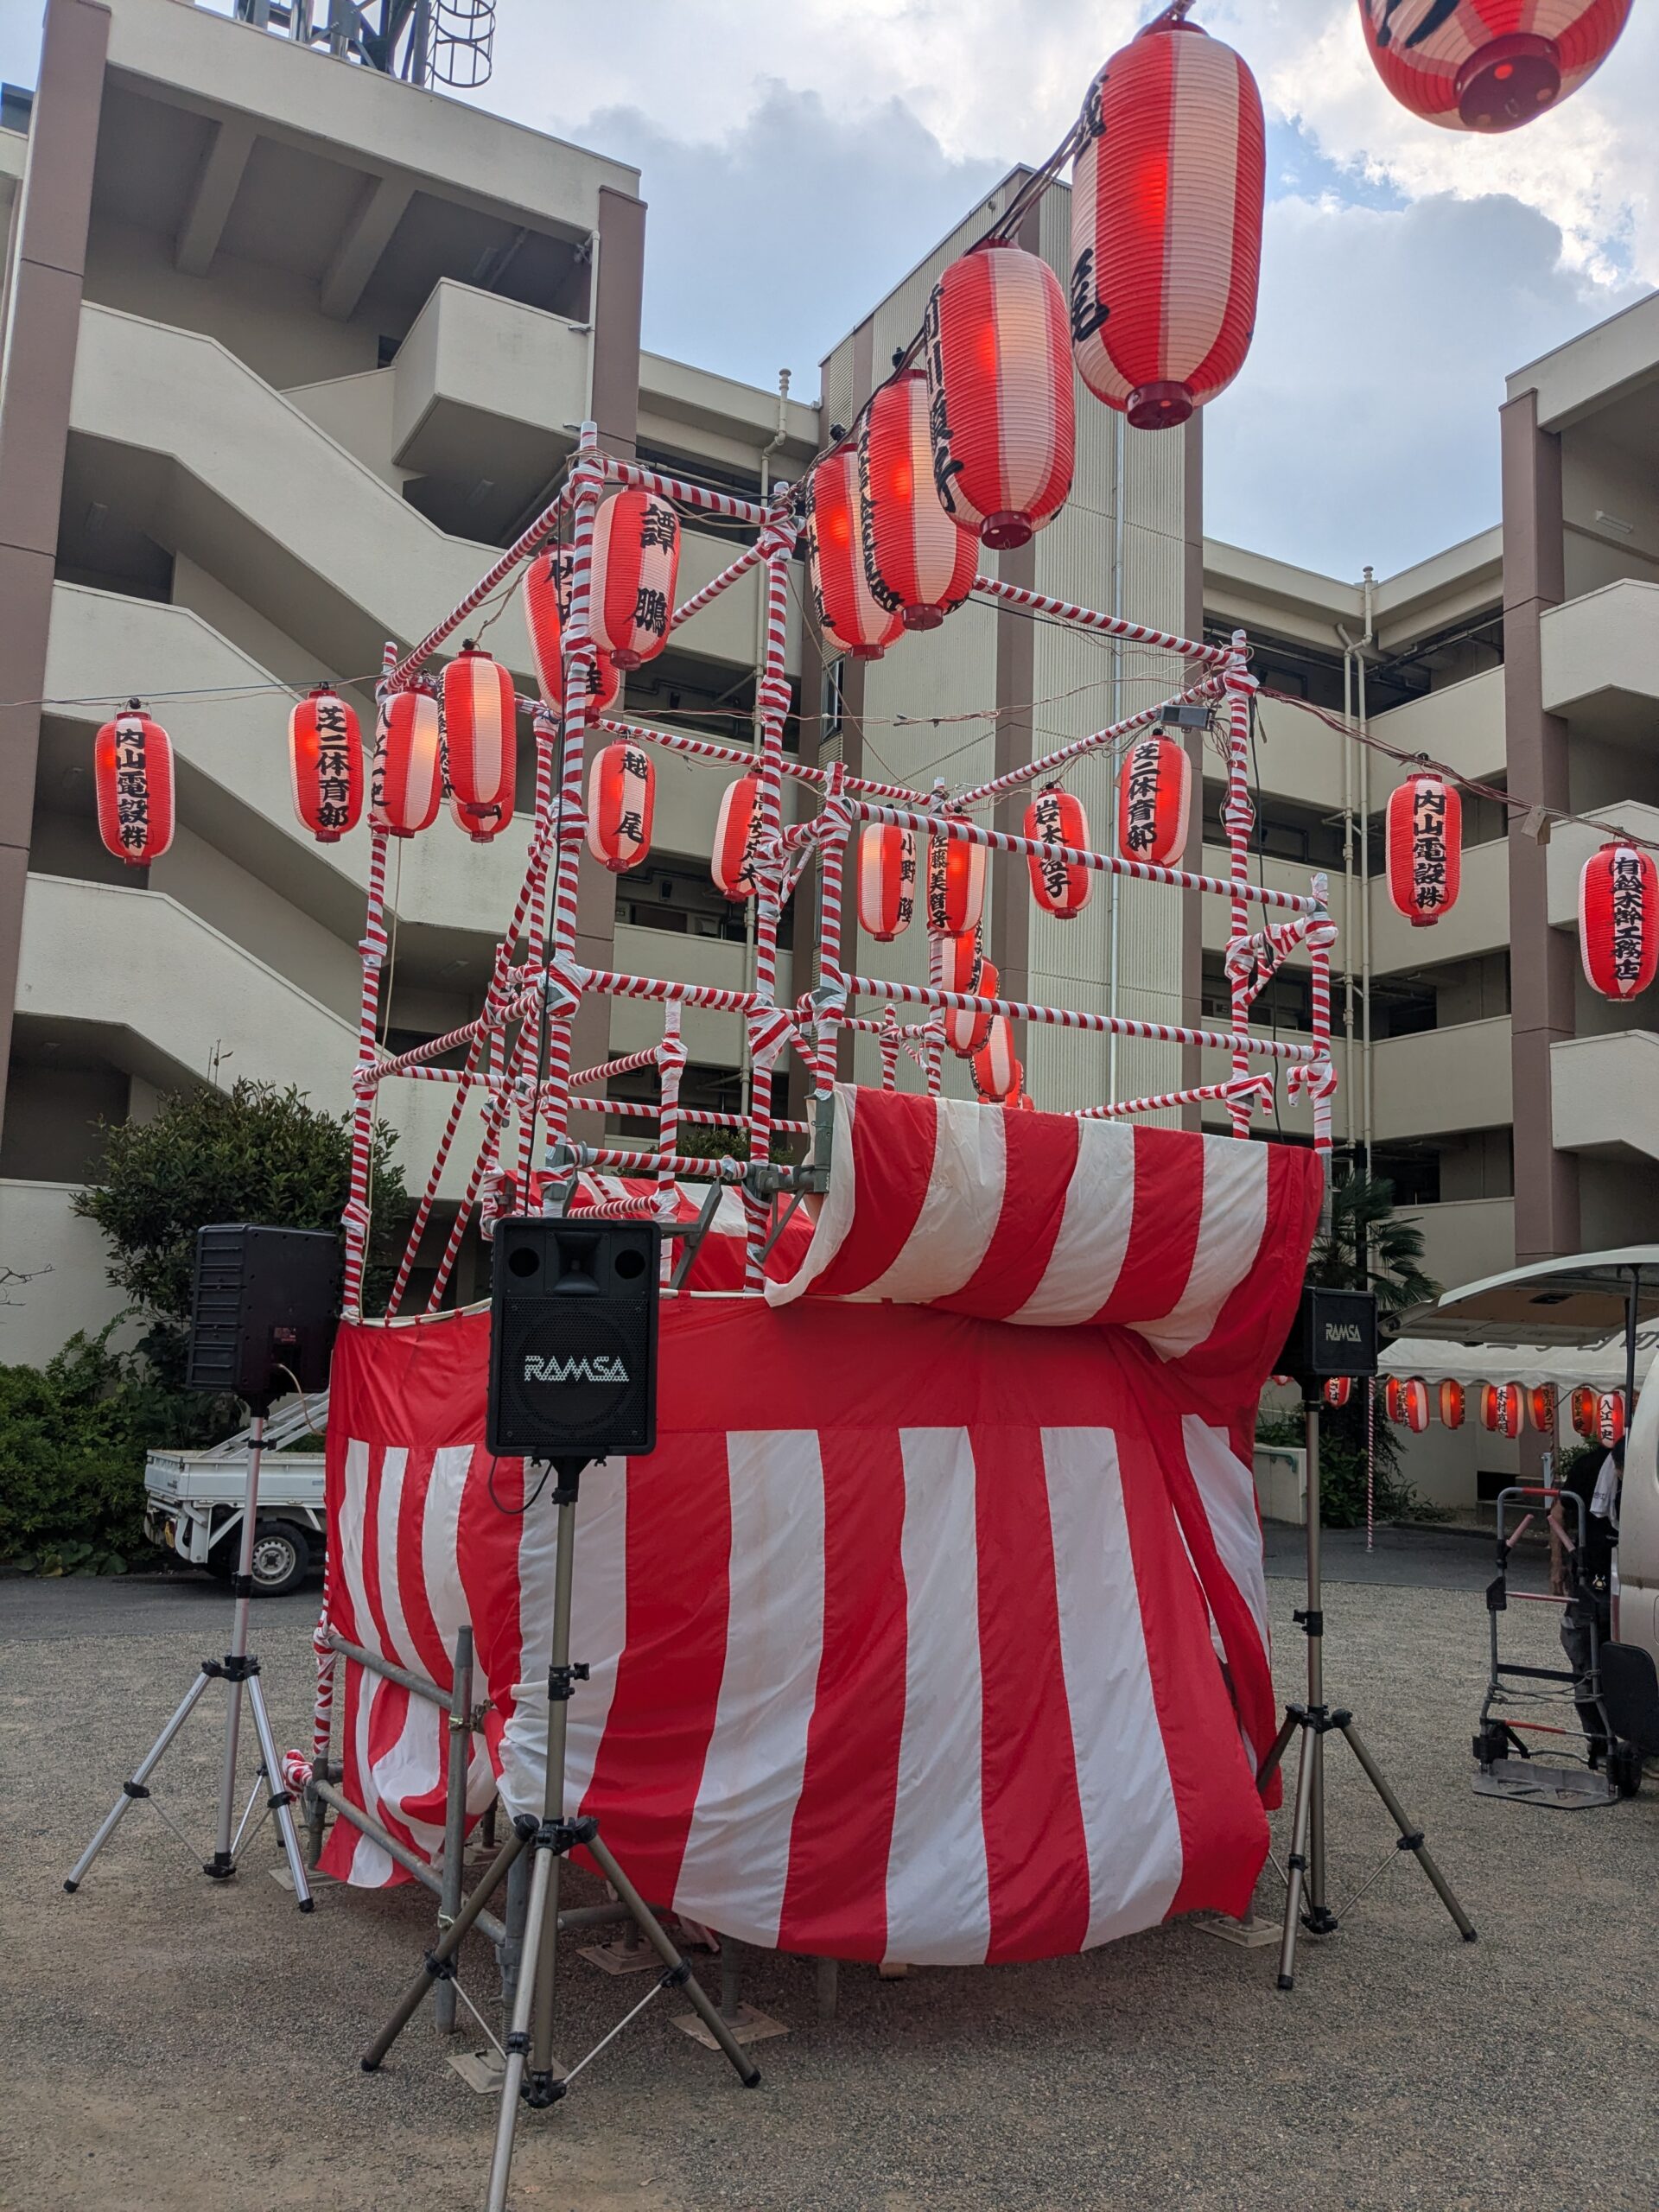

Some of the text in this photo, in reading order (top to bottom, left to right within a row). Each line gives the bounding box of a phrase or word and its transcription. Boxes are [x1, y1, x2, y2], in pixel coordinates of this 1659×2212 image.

[315, 705, 353, 829] 芝二体育部
[611, 751, 648, 844] 越尾
[1126, 743, 1163, 852] 芝二体育部
[524, 1355, 630, 1382] RAMSA
[1325, 1323, 1362, 1342] RAMSA
